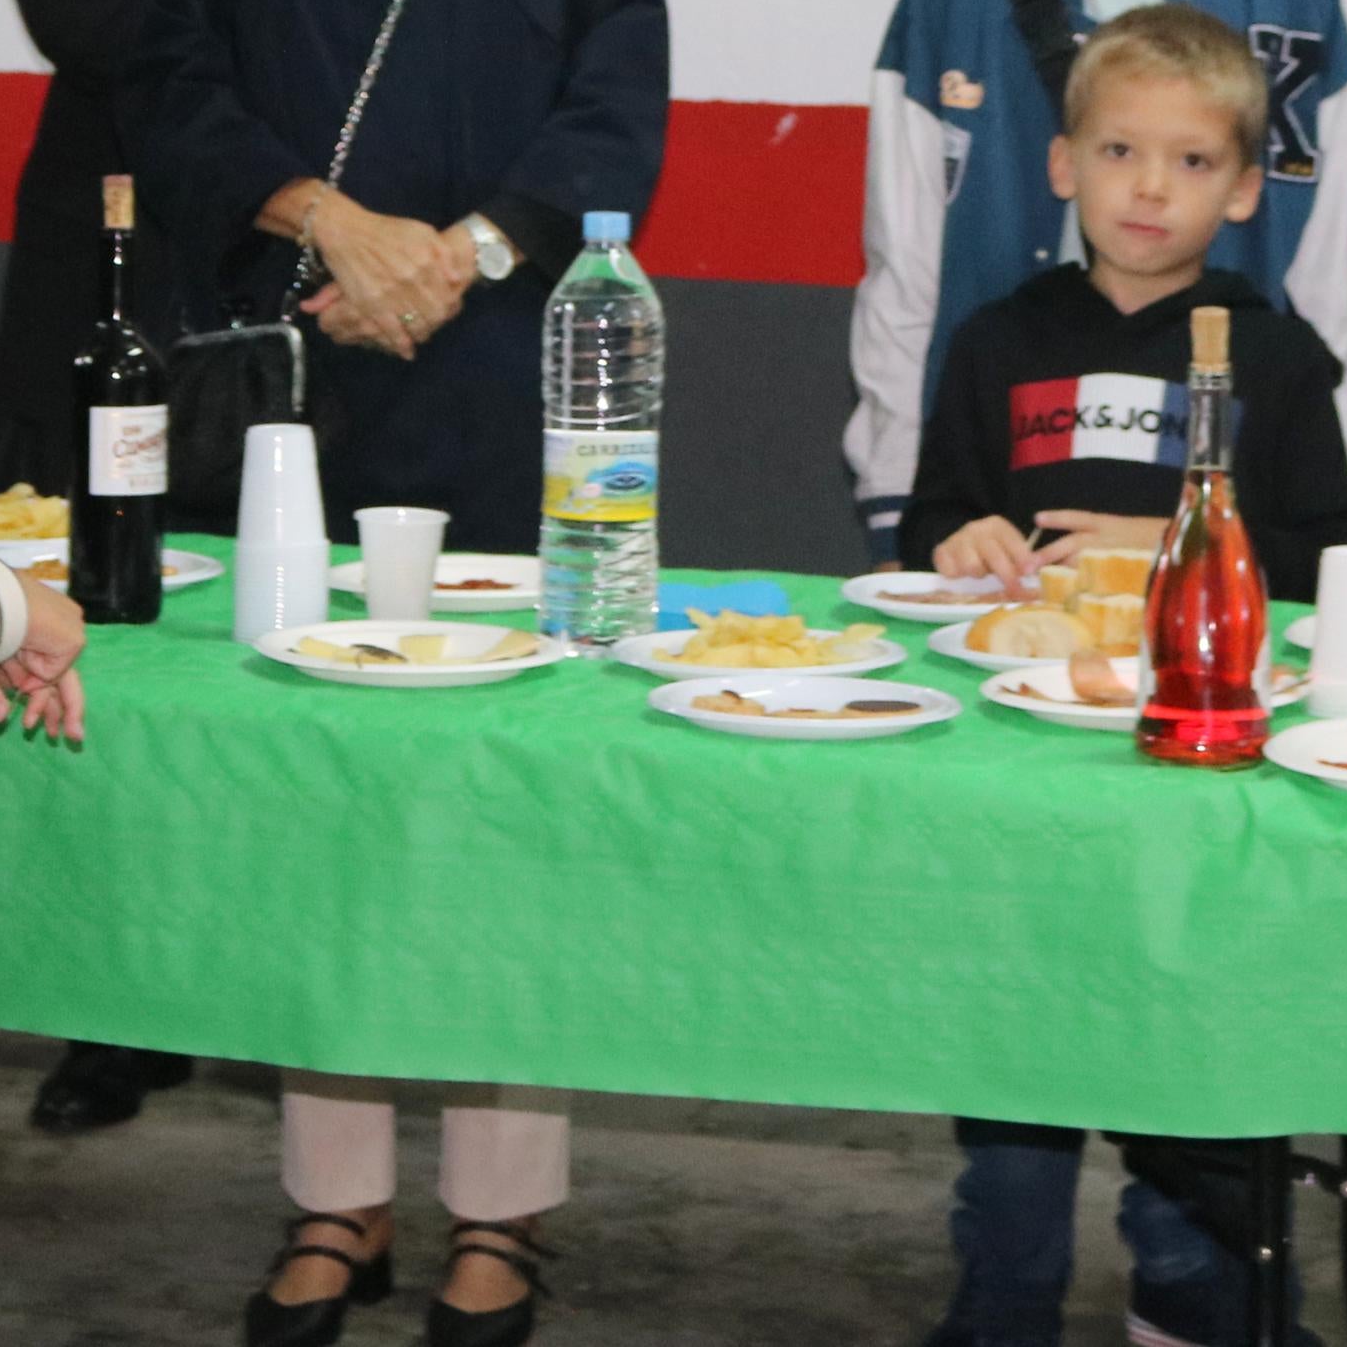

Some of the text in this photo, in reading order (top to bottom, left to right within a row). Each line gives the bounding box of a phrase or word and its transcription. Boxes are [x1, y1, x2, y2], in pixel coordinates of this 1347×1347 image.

[1012, 404, 1189, 443] JACK & JON
